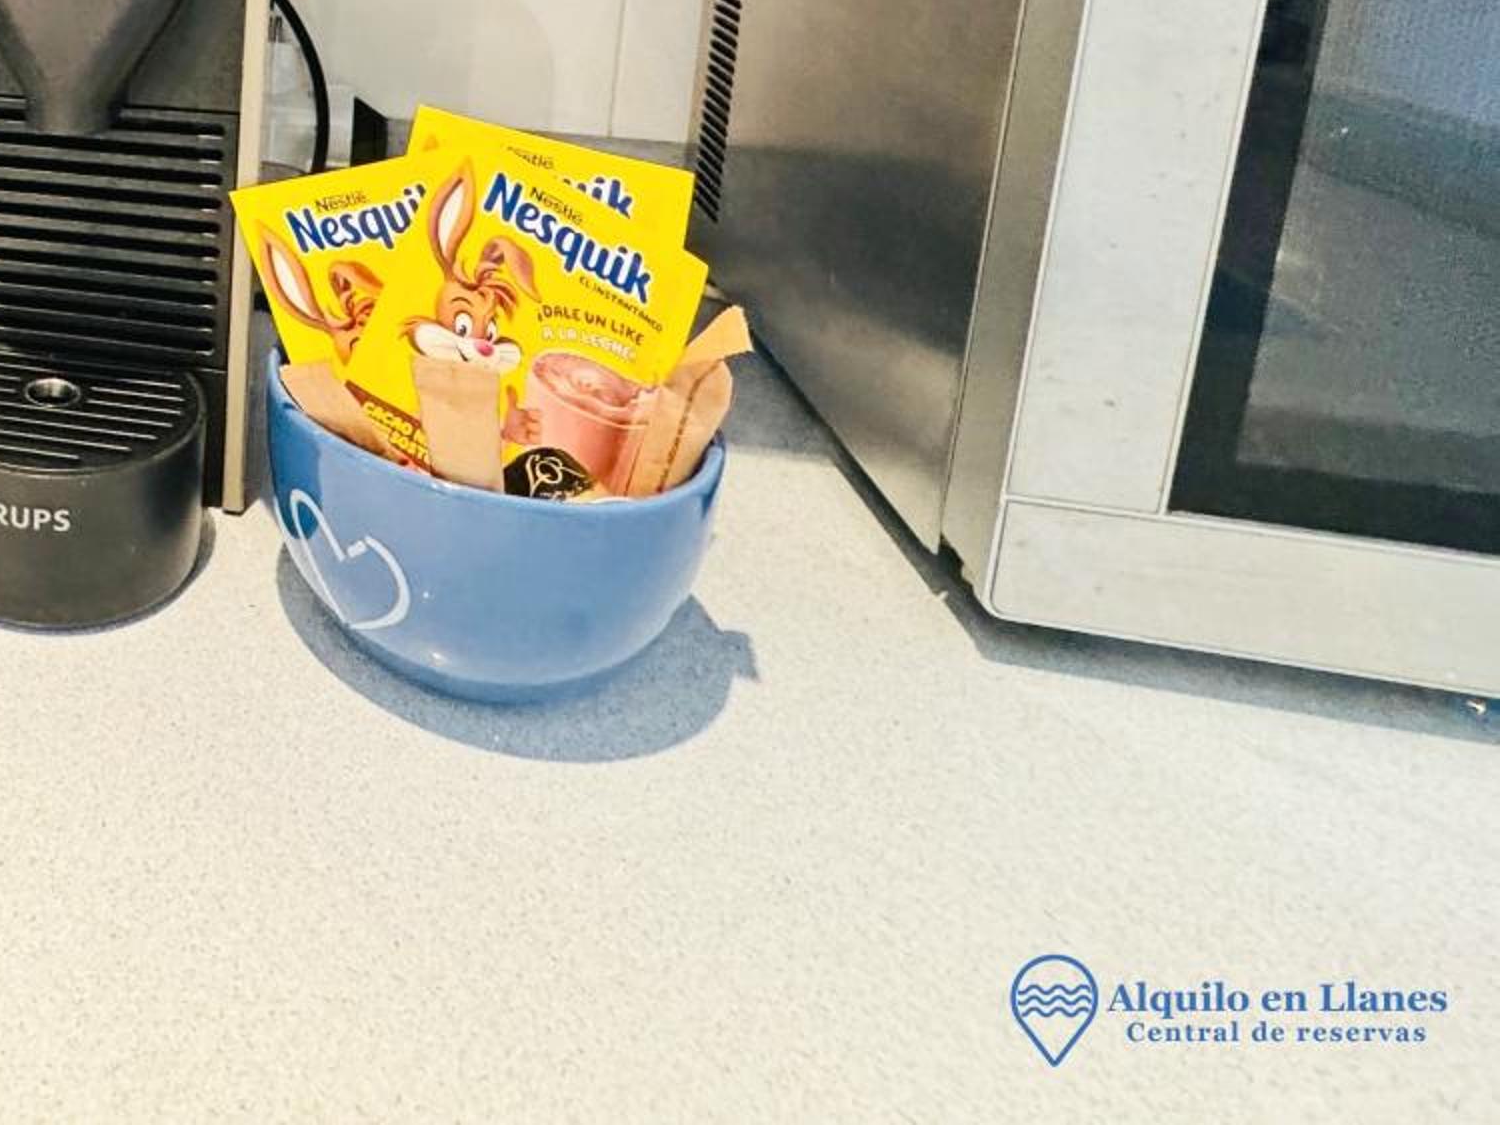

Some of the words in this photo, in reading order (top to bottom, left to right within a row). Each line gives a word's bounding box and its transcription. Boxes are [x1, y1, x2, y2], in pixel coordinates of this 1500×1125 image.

[286, 181, 428, 253] Nesqui
[484, 173, 650, 303] Nesquik
[585, 311, 607, 328] UN
[611, 317, 645, 346] LIKE
[364, 402, 413, 435] CACAO
